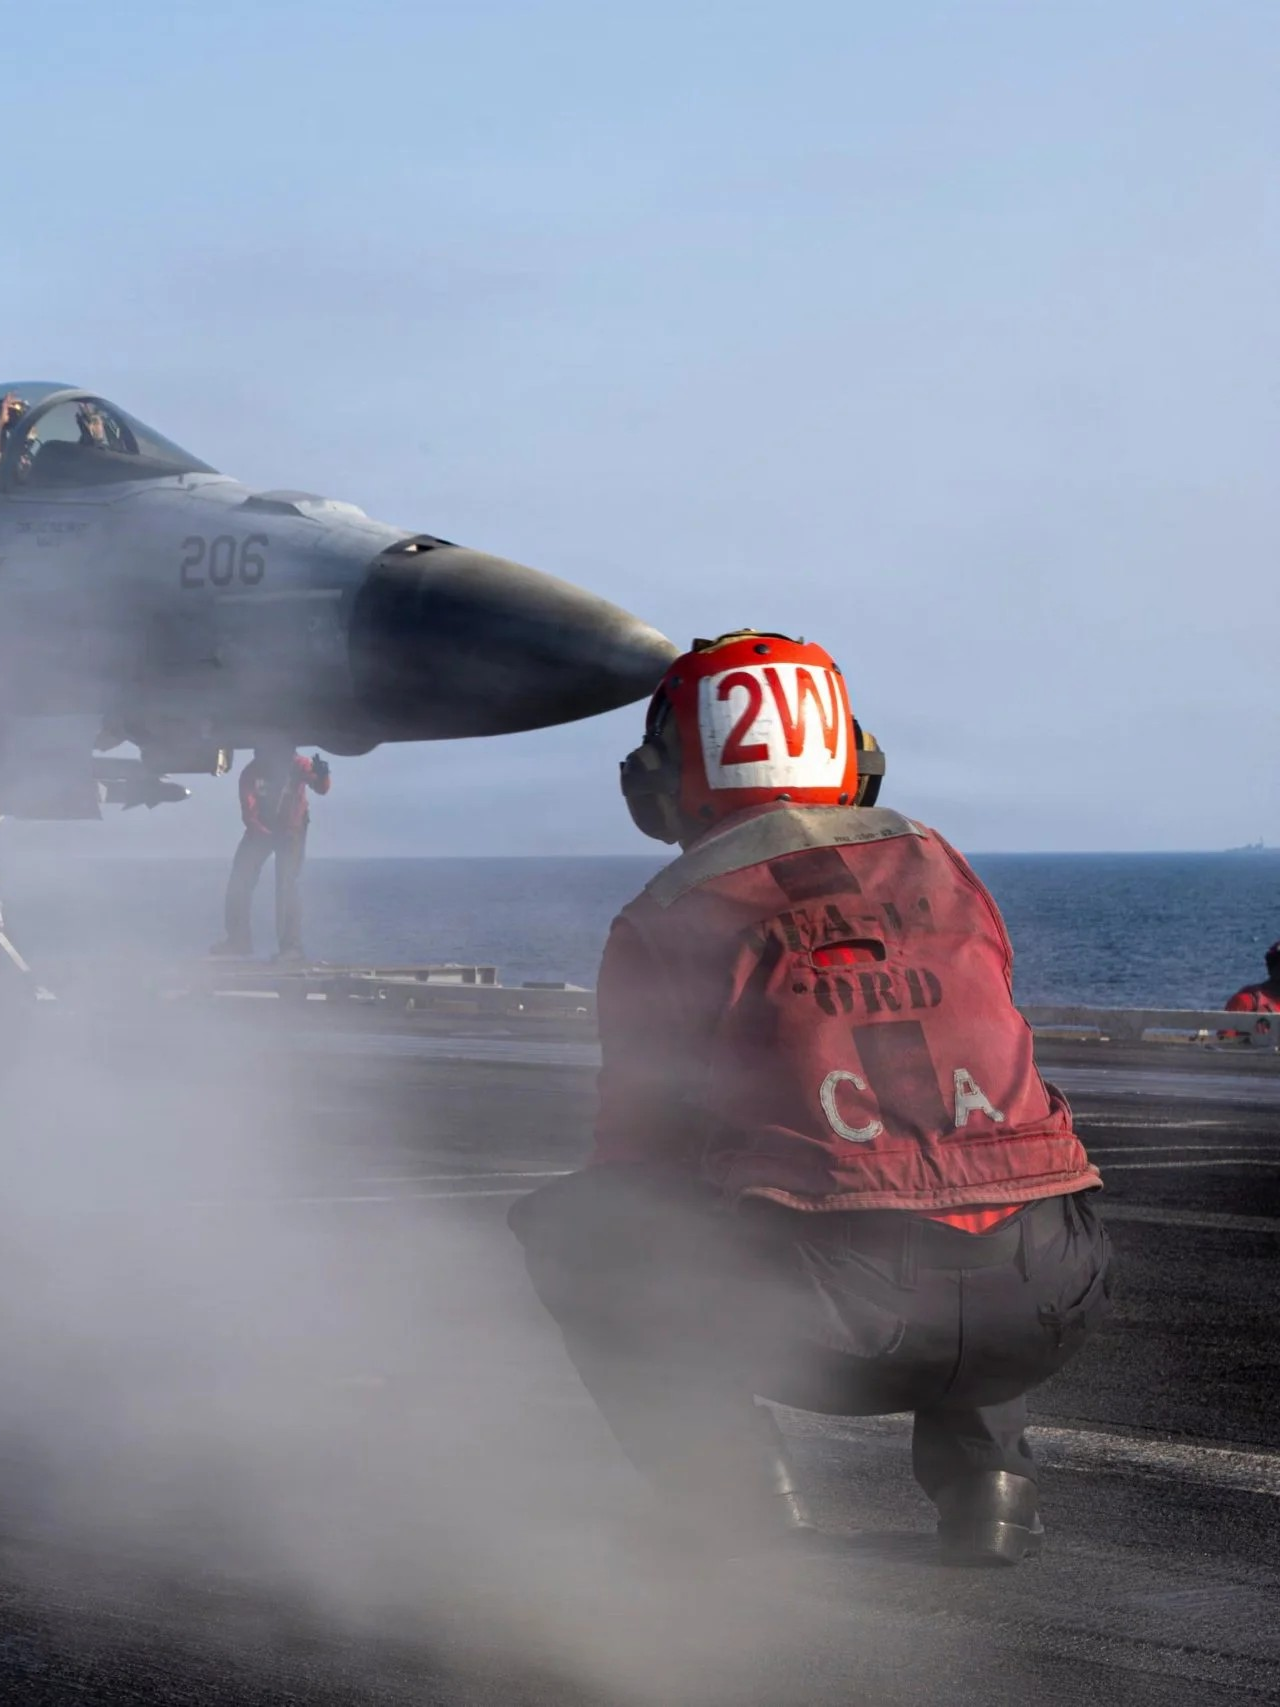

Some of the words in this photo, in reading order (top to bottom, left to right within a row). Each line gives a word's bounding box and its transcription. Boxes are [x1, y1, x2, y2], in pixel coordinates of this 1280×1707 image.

[179, 532, 270, 589] 206
[716, 666, 839, 766] 2W
[813, 967, 943, 1016] ORD
[819, 1069, 882, 1142] C
[952, 1068, 1004, 1127] A
